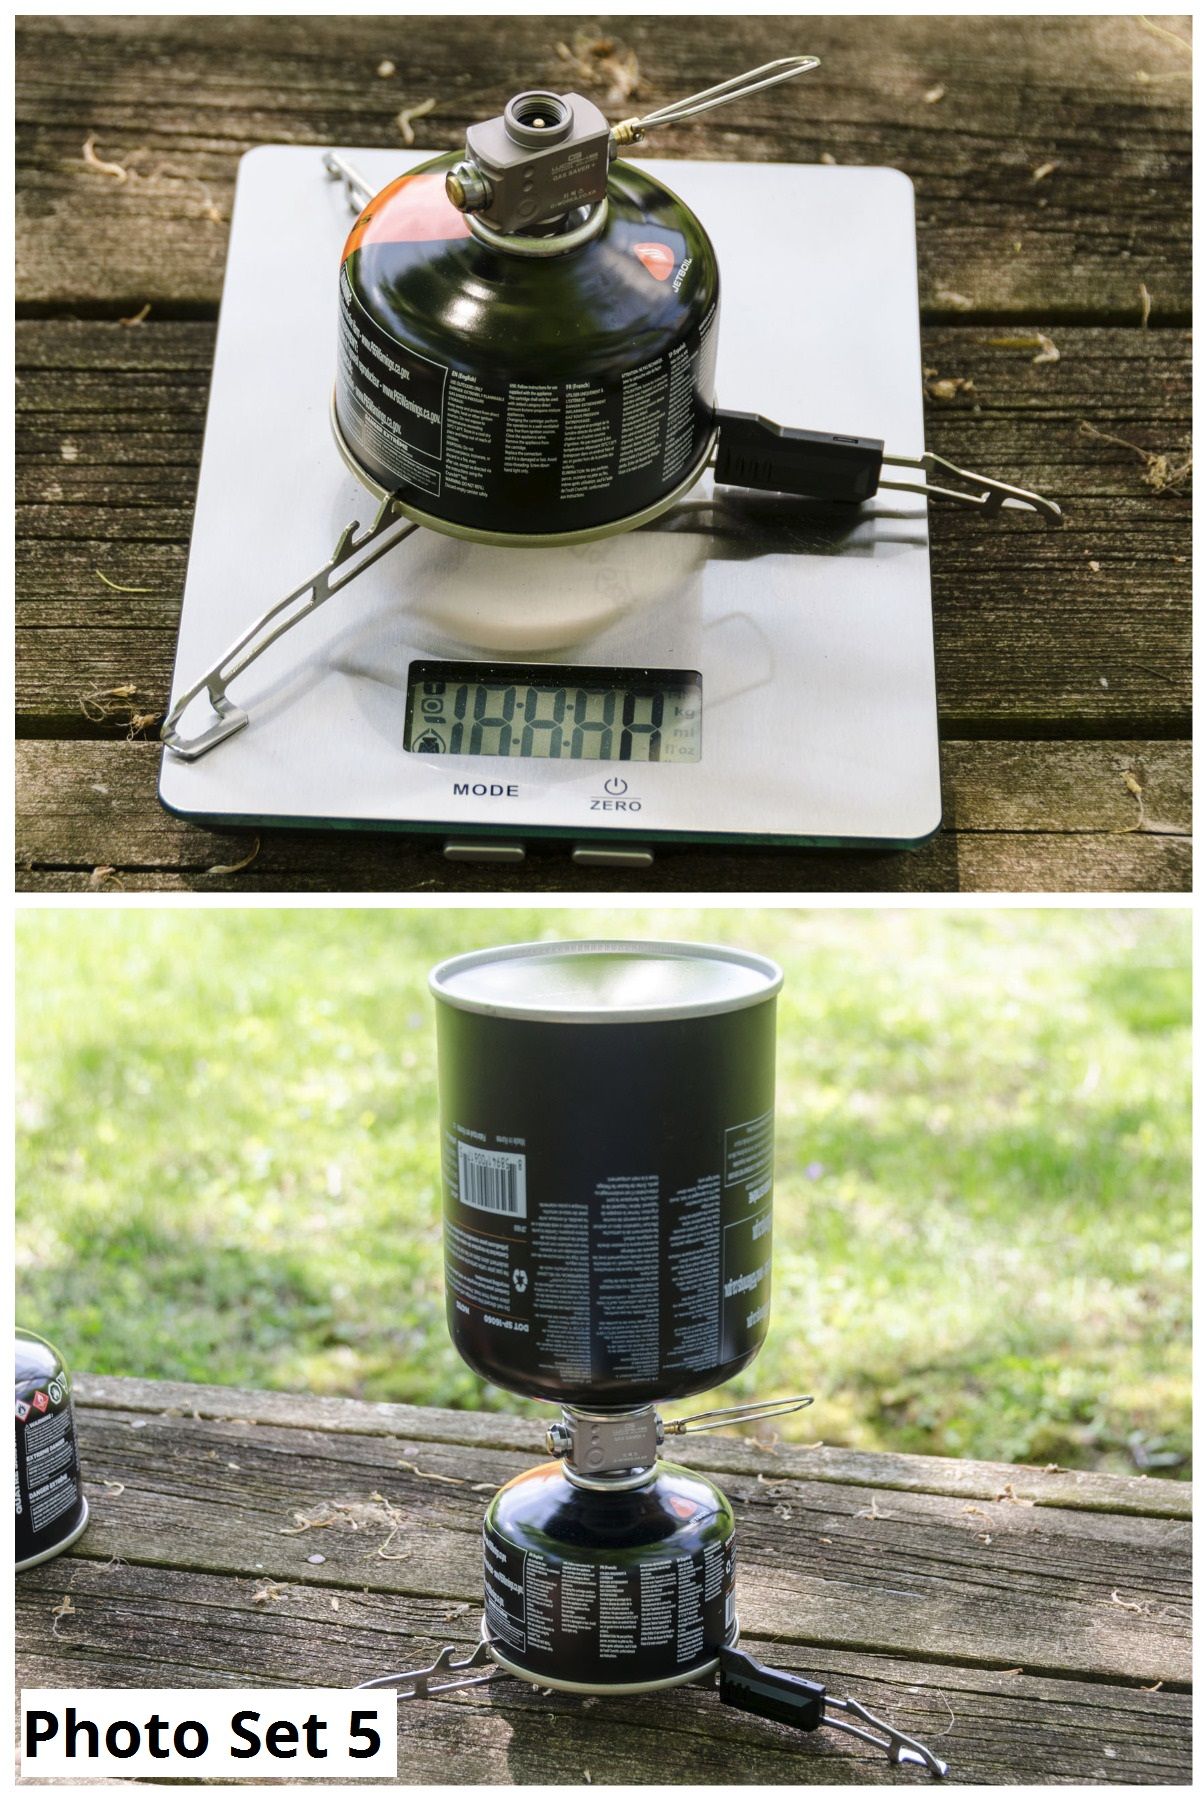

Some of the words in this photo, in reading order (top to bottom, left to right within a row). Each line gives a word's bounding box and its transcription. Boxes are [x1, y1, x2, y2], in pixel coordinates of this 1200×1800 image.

[672, 258, 693, 293] JETBOIL
[453, 783, 519, 797] MODE
[590, 800, 642, 812] ZERO
